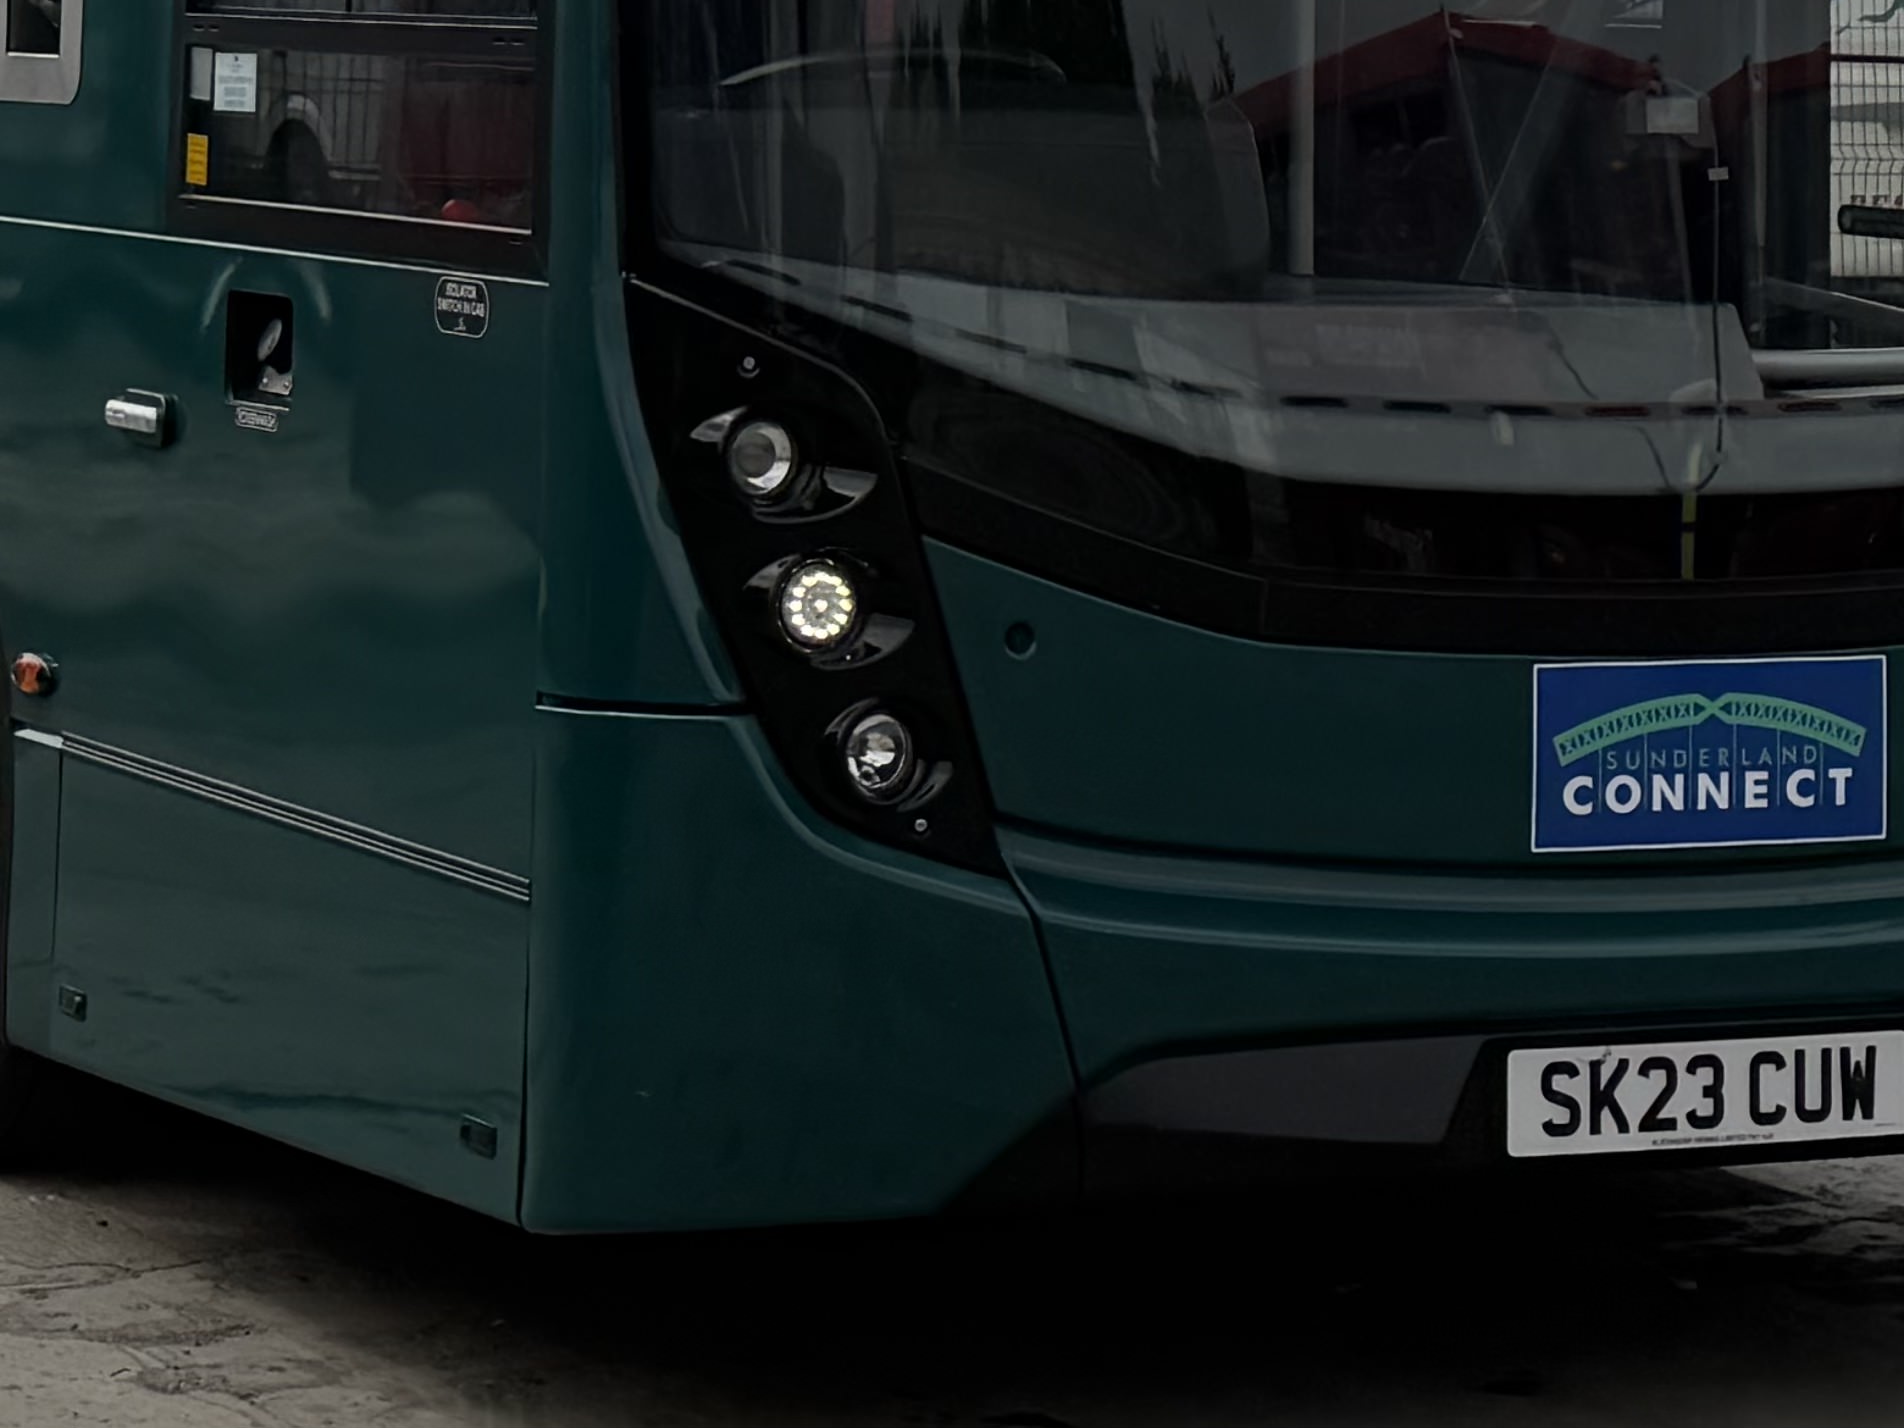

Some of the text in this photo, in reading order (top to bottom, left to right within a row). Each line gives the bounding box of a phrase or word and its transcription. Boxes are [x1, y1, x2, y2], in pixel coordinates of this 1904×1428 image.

[1605, 745, 1818, 771] SUNDERLAND
[1561, 767, 1854, 817] CONNECT
[1539, 1044, 1878, 1138] SK23 CUW
